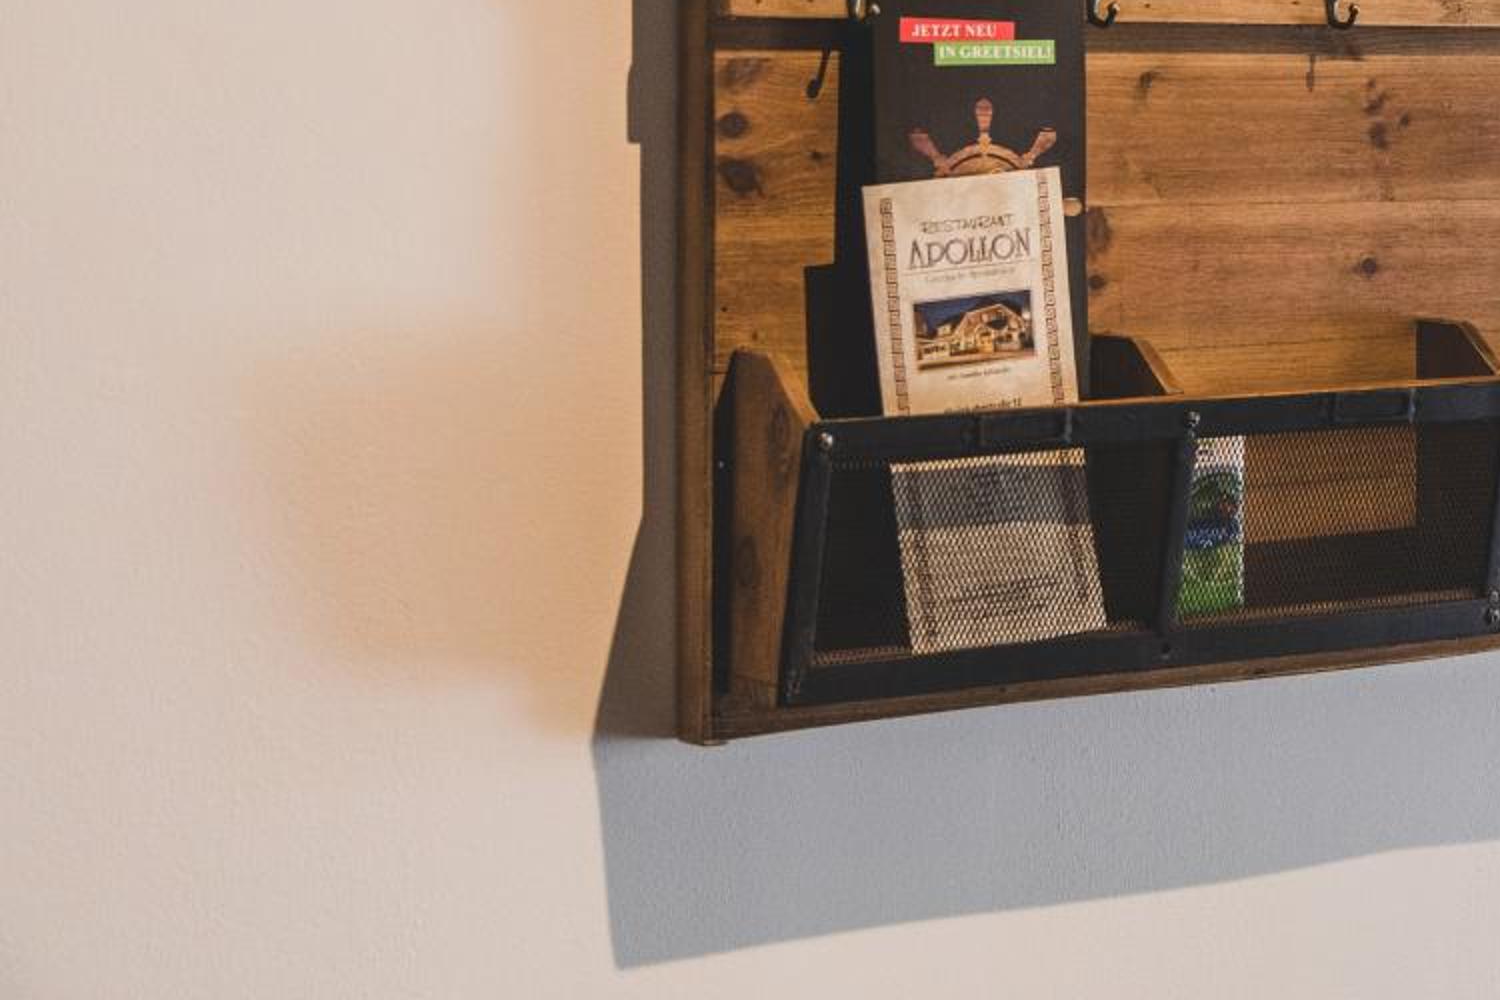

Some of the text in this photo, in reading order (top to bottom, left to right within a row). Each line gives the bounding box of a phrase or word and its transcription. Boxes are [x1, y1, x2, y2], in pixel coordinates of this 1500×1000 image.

[911, 23, 997, 38] JETZT NEU
[939, 45, 956, 60] IN
[920, 213, 1014, 234] RESTAURANT
[909, 227, 1032, 270] APOLLON
